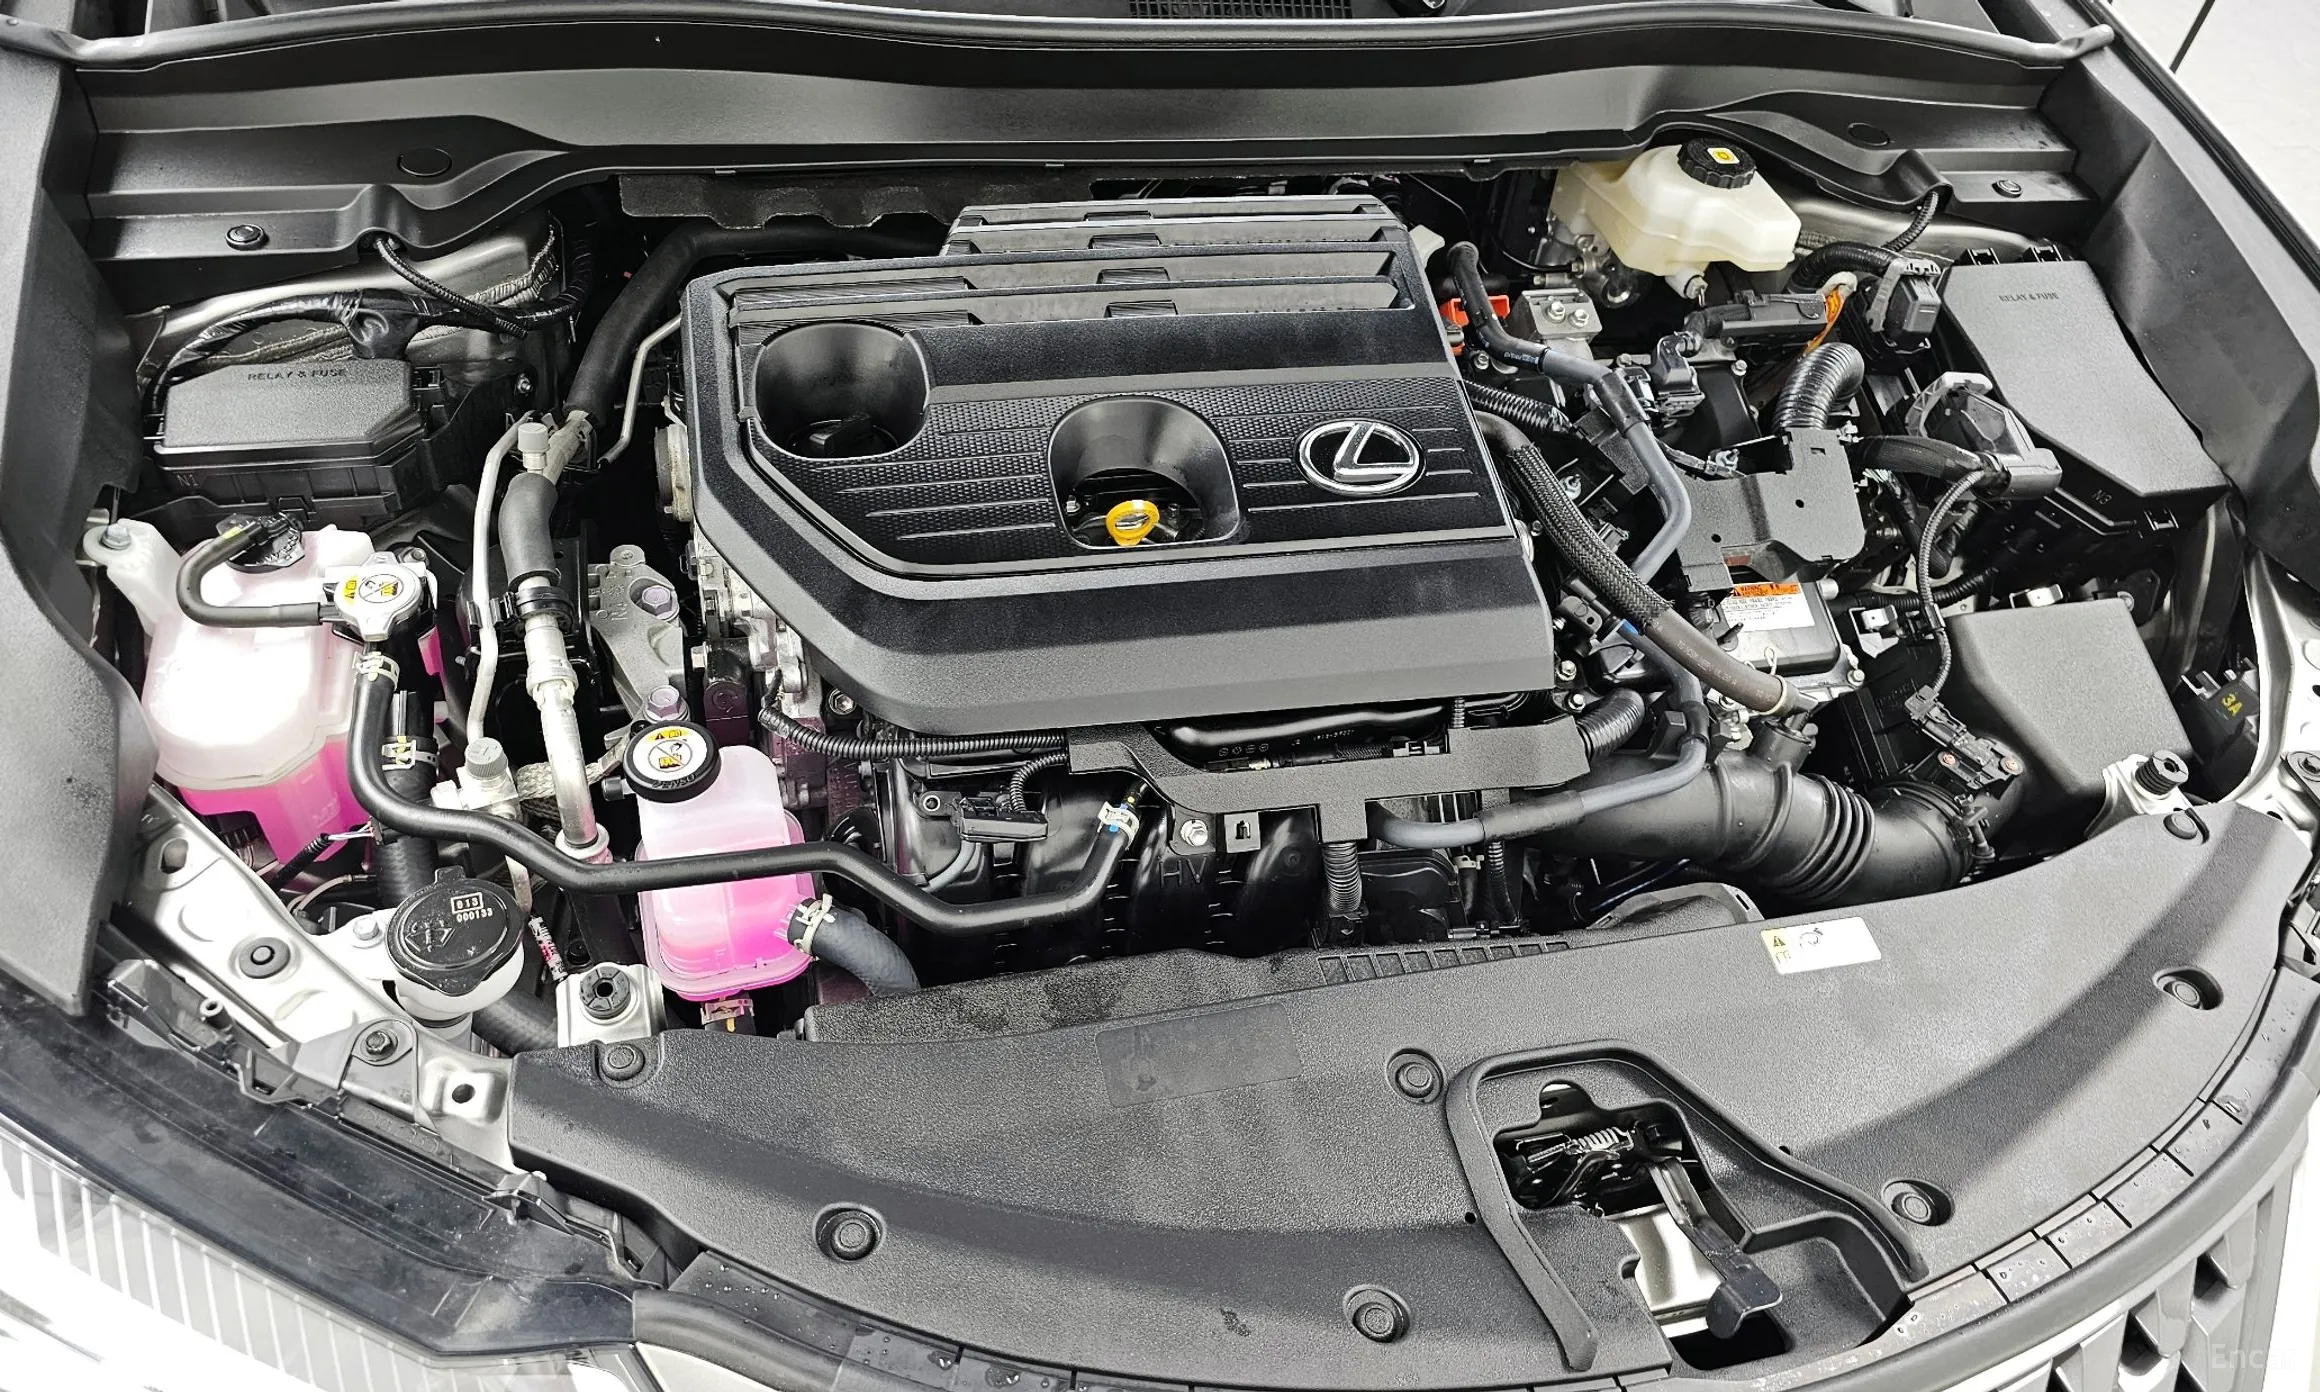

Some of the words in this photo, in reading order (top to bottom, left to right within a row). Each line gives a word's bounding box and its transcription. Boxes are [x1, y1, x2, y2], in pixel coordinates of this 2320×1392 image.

[1998, 294, 2027, 302] RELAY
[2036, 291, 2059, 300] FUSE
[247, 371, 293, 381] RELAY
[298, 370, 307, 378] &
[312, 368, 346, 378] FUSE
[2221, 692, 2243, 717] 3A
[652, 773, 695, 790] DENSO
[1159, 853, 1208, 888] HV
[456, 907, 493, 923] 000133
